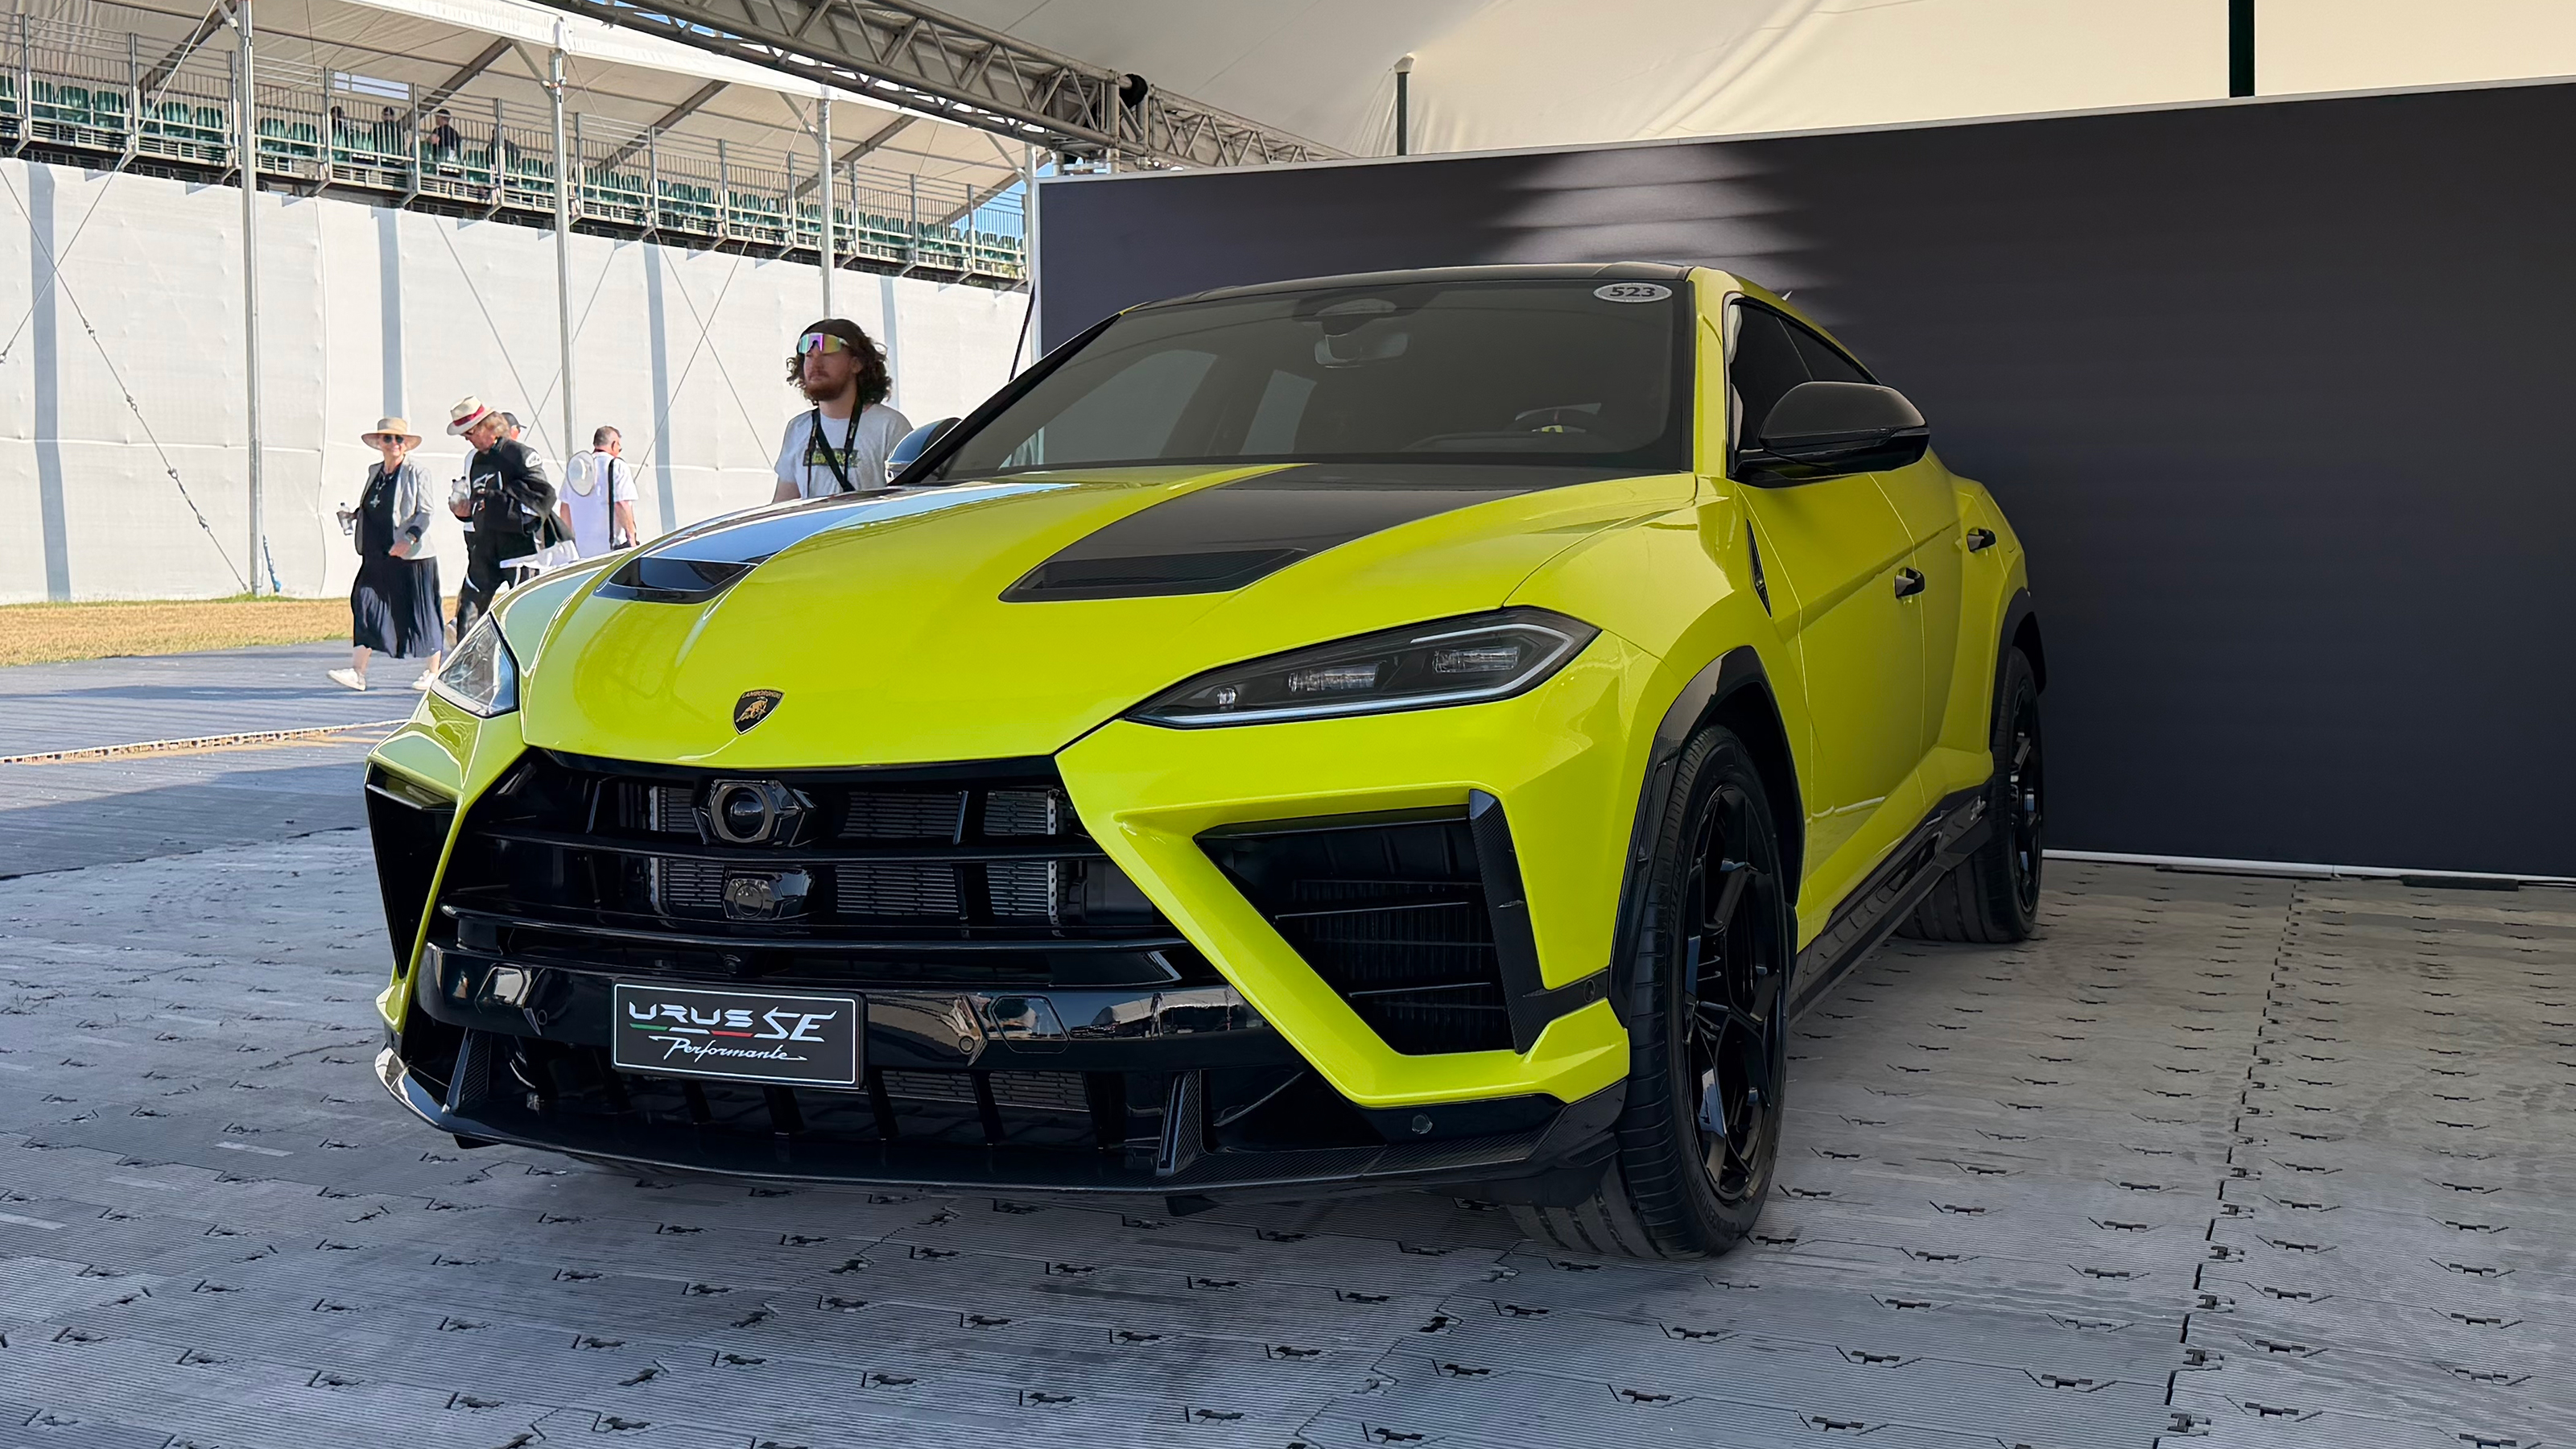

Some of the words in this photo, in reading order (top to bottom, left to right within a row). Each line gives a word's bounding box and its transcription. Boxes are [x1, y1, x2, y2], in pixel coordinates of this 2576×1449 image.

[1609, 287, 1656, 297] 523
[629, 1001, 753, 1028] URUS
[753, 1006, 838, 1042] SE
[648, 1034, 808, 1063] Performante
